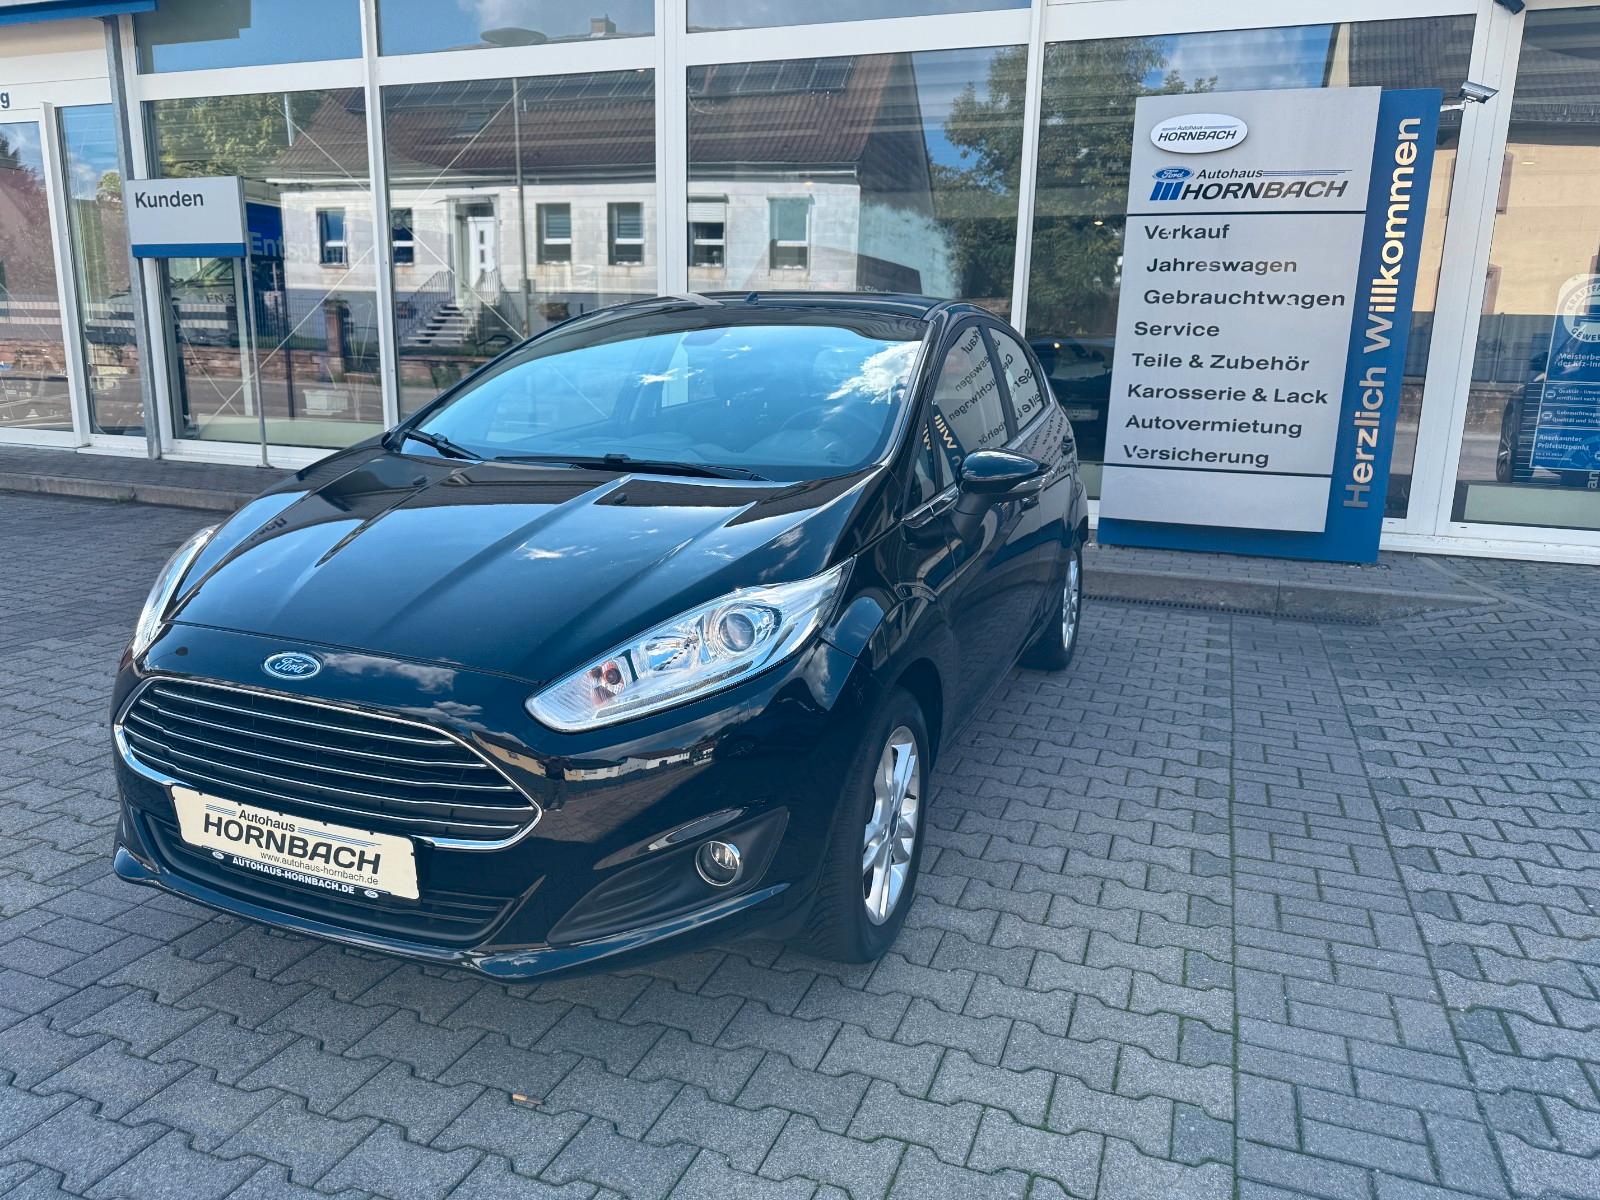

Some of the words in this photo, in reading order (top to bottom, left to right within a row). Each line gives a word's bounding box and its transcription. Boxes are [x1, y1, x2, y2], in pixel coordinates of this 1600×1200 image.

[1158, 130, 1237, 141] HORNBACH
[1197, 168, 1263, 180] Autohaus
[135, 191, 204, 208] Kunden
[1181, 180, 1349, 200] HORNBACH
[1144, 224, 1230, 240] Verkauf
[1363, 117, 1421, 354] Willkommen
[1147, 257, 1297, 276] Jahreswagen
[1144, 289, 1345, 310] Gebrauchtwagen
[1134, 321, 1219, 337] Service
[1132, 353, 1182, 368] Teile
[1189, 354, 1204, 369] &
[1210, 354, 1310, 371] Zubehör
[1128, 384, 1246, 401] Karosserie
[1252, 388, 1267, 402] &
[1274, 388, 1328, 404] Lack
[1125, 415, 1302, 438] Autovermietung
[1343, 366, 1387, 508] Herzlich
[1124, 444, 1269, 467] Versicherung
[238, 809, 296, 832] Autohaus
[203, 813, 381, 874] HORNBACH
[232, 856, 355, 895] AUTOHAUS-HORNBACH.DE
[260, 851, 379, 885] www.autohaus-hornbach.de
